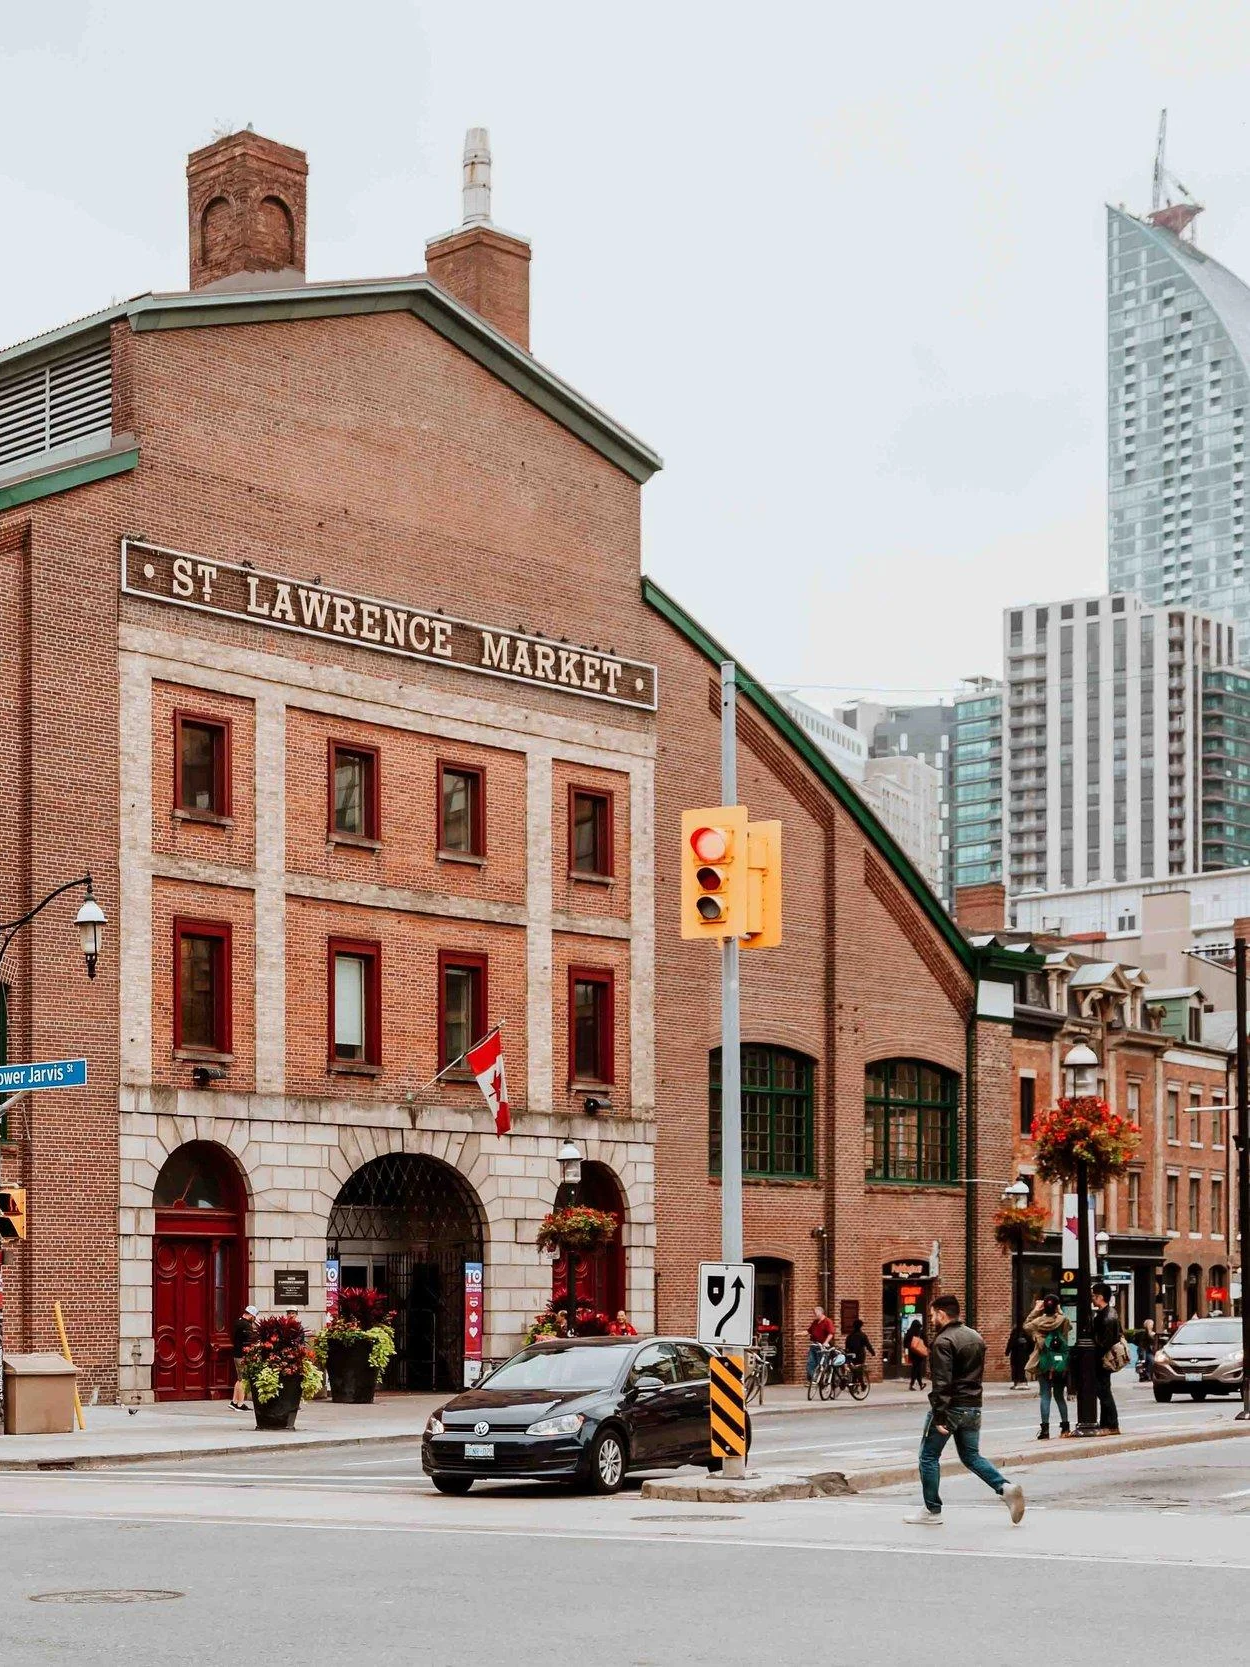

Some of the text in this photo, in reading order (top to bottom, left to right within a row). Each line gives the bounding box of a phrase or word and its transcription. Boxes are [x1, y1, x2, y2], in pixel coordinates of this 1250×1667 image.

[247, 576, 452, 657] LAWRENCE
[481, 632, 622, 694] MARKET
[28, 1064, 64, 1083] Jarvis
[66, 1063, 74, 1073] St
